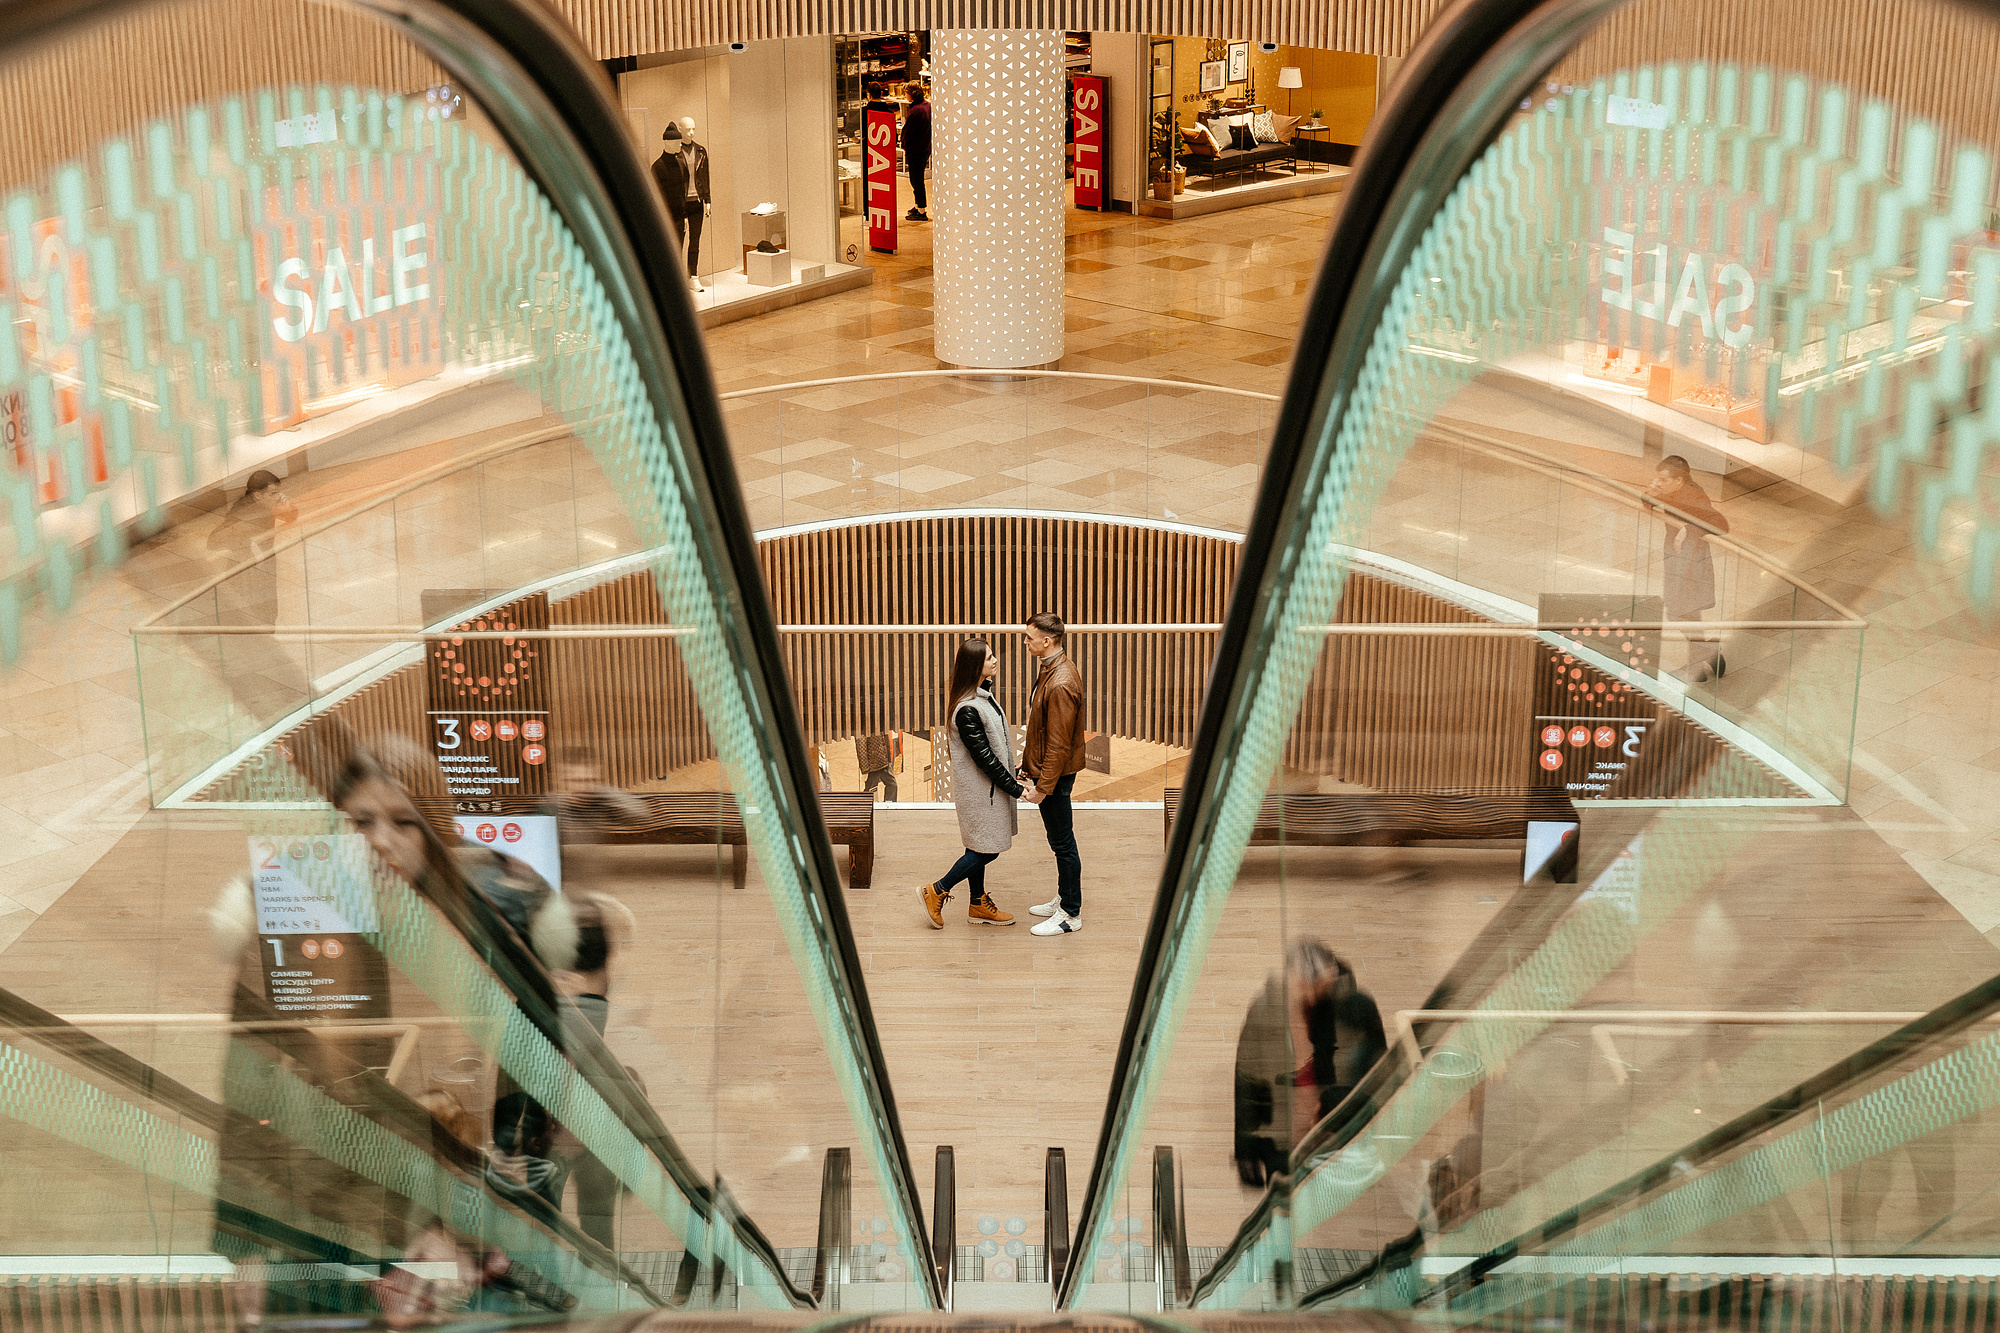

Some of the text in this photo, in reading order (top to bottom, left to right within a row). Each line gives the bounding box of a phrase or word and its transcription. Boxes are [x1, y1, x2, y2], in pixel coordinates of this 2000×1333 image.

[1075, 87, 1099, 190] SALE
[867, 121, 891, 231] SALE
[272, 222, 430, 342] SALE
[437, 719, 461, 749] 3
[438, 755, 490, 763] КИНОМАКС
[257, 842, 281, 869] 2
[266, 938, 285, 967] 1
[271, 979, 309, 987] ПОСУДА
